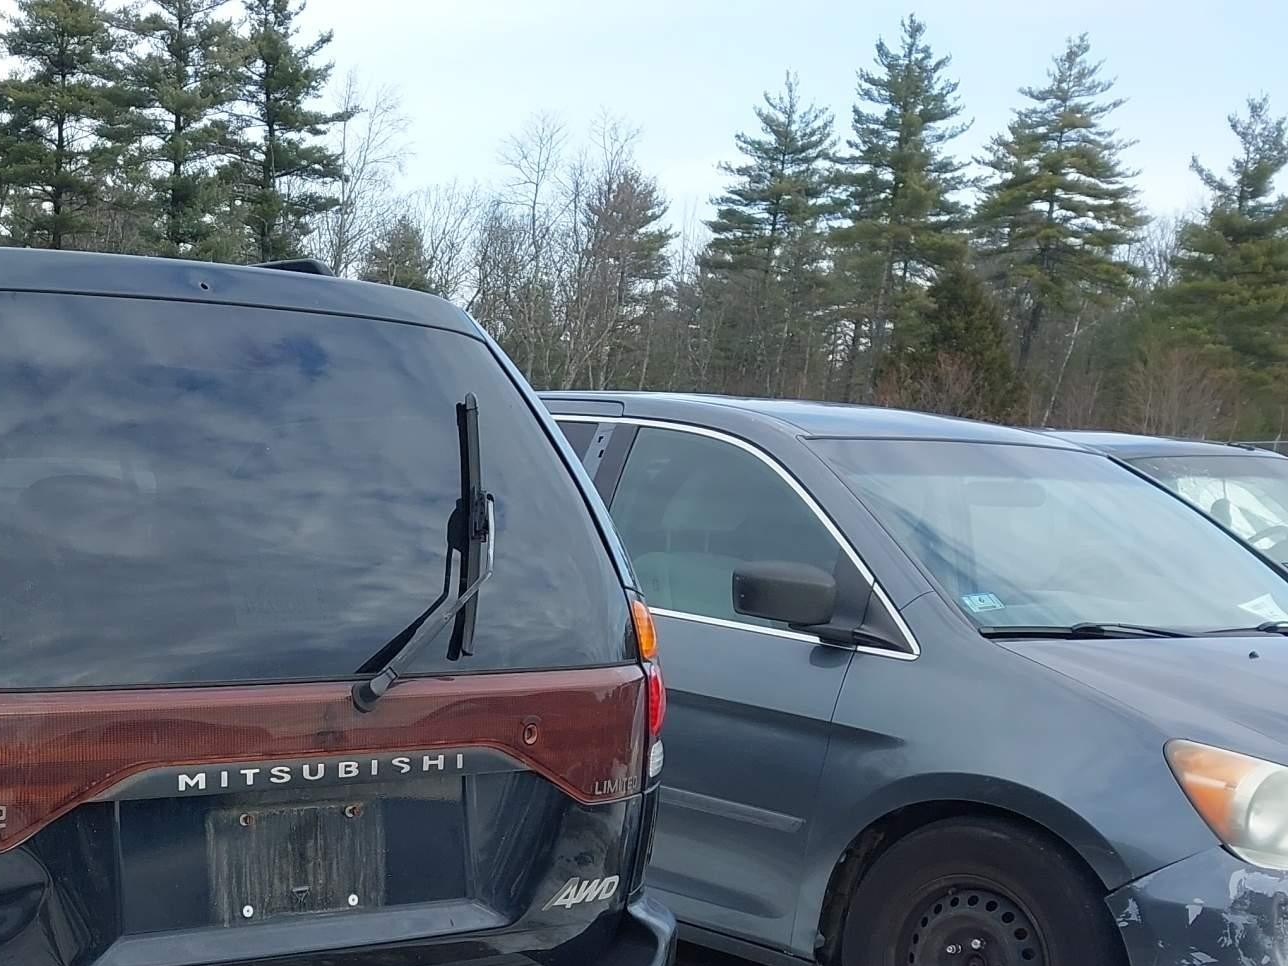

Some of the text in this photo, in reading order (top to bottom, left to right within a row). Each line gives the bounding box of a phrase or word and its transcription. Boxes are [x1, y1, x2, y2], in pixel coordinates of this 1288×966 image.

[177, 753, 464, 792] MITSUBISHI
[594, 775, 638, 796] LIMITED
[541, 875, 620, 912] 4WD
